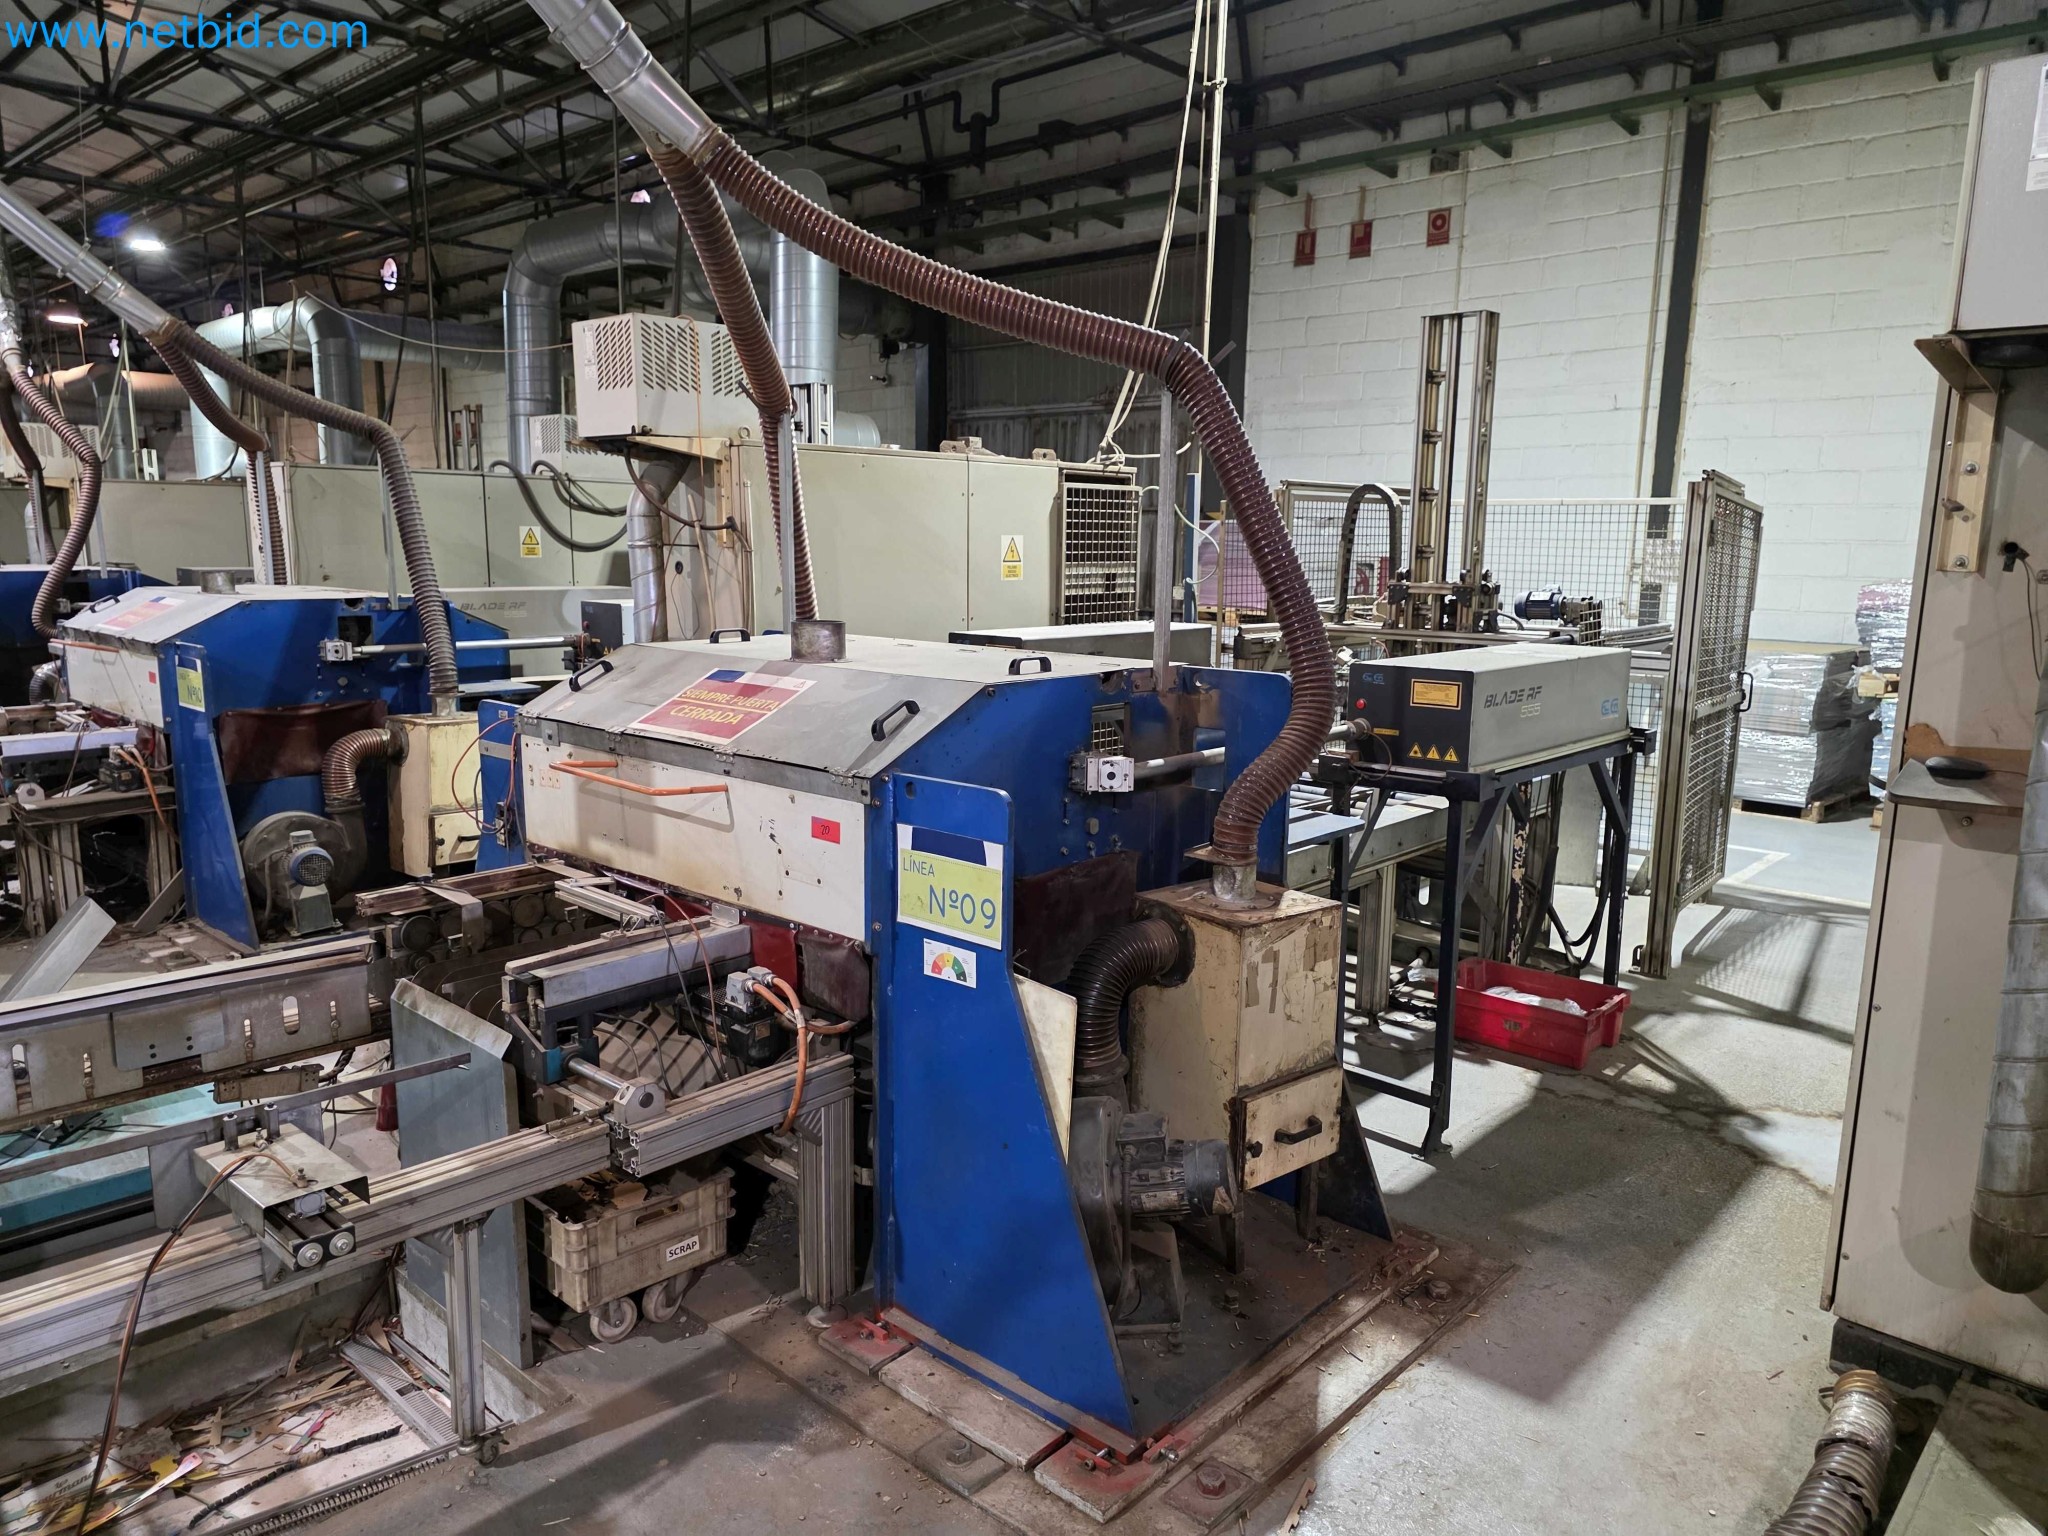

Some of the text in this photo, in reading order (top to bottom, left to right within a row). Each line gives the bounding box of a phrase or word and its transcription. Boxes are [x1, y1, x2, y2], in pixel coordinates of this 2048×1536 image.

[681, 688, 782, 711] SIEMPRE PUERTA
[1483, 685, 1543, 709] BLADE RF
[669, 704, 745, 725] CERRADA
[902, 854, 936, 878] LÍNEA
[668, 1240, 698, 1258] SCRAP
